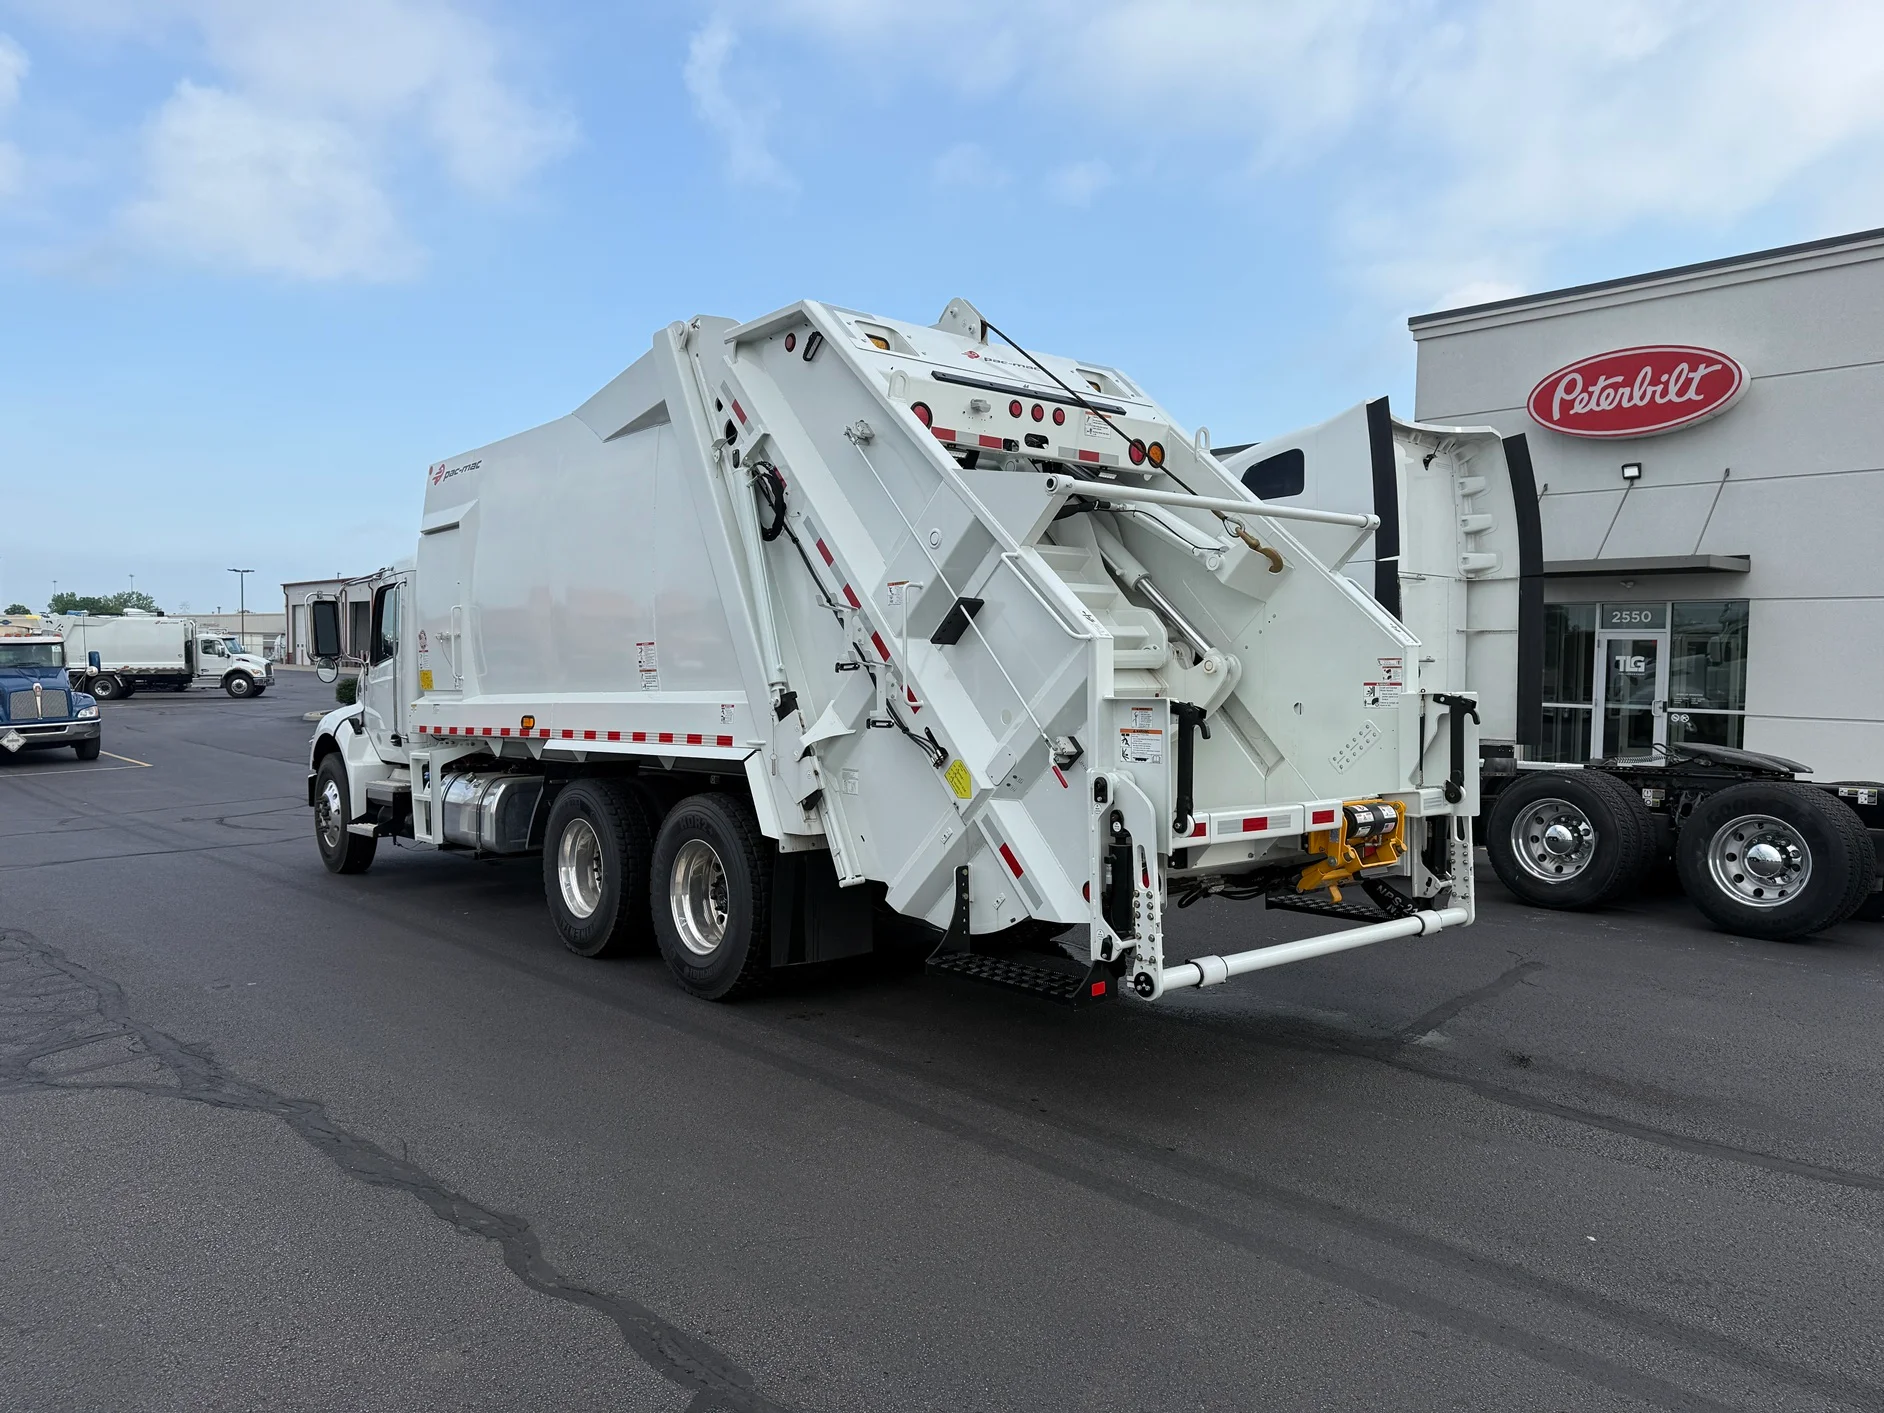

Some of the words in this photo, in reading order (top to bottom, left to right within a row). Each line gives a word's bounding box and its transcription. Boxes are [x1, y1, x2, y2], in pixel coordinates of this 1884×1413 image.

[984, 356, 1041, 372] pac-mac
[1552, 362, 1723, 421] Peterbilt
[443, 459, 482, 482] pac-mac
[1611, 610, 1653, 623] 2550
[1615, 655, 1646, 673] TLG
